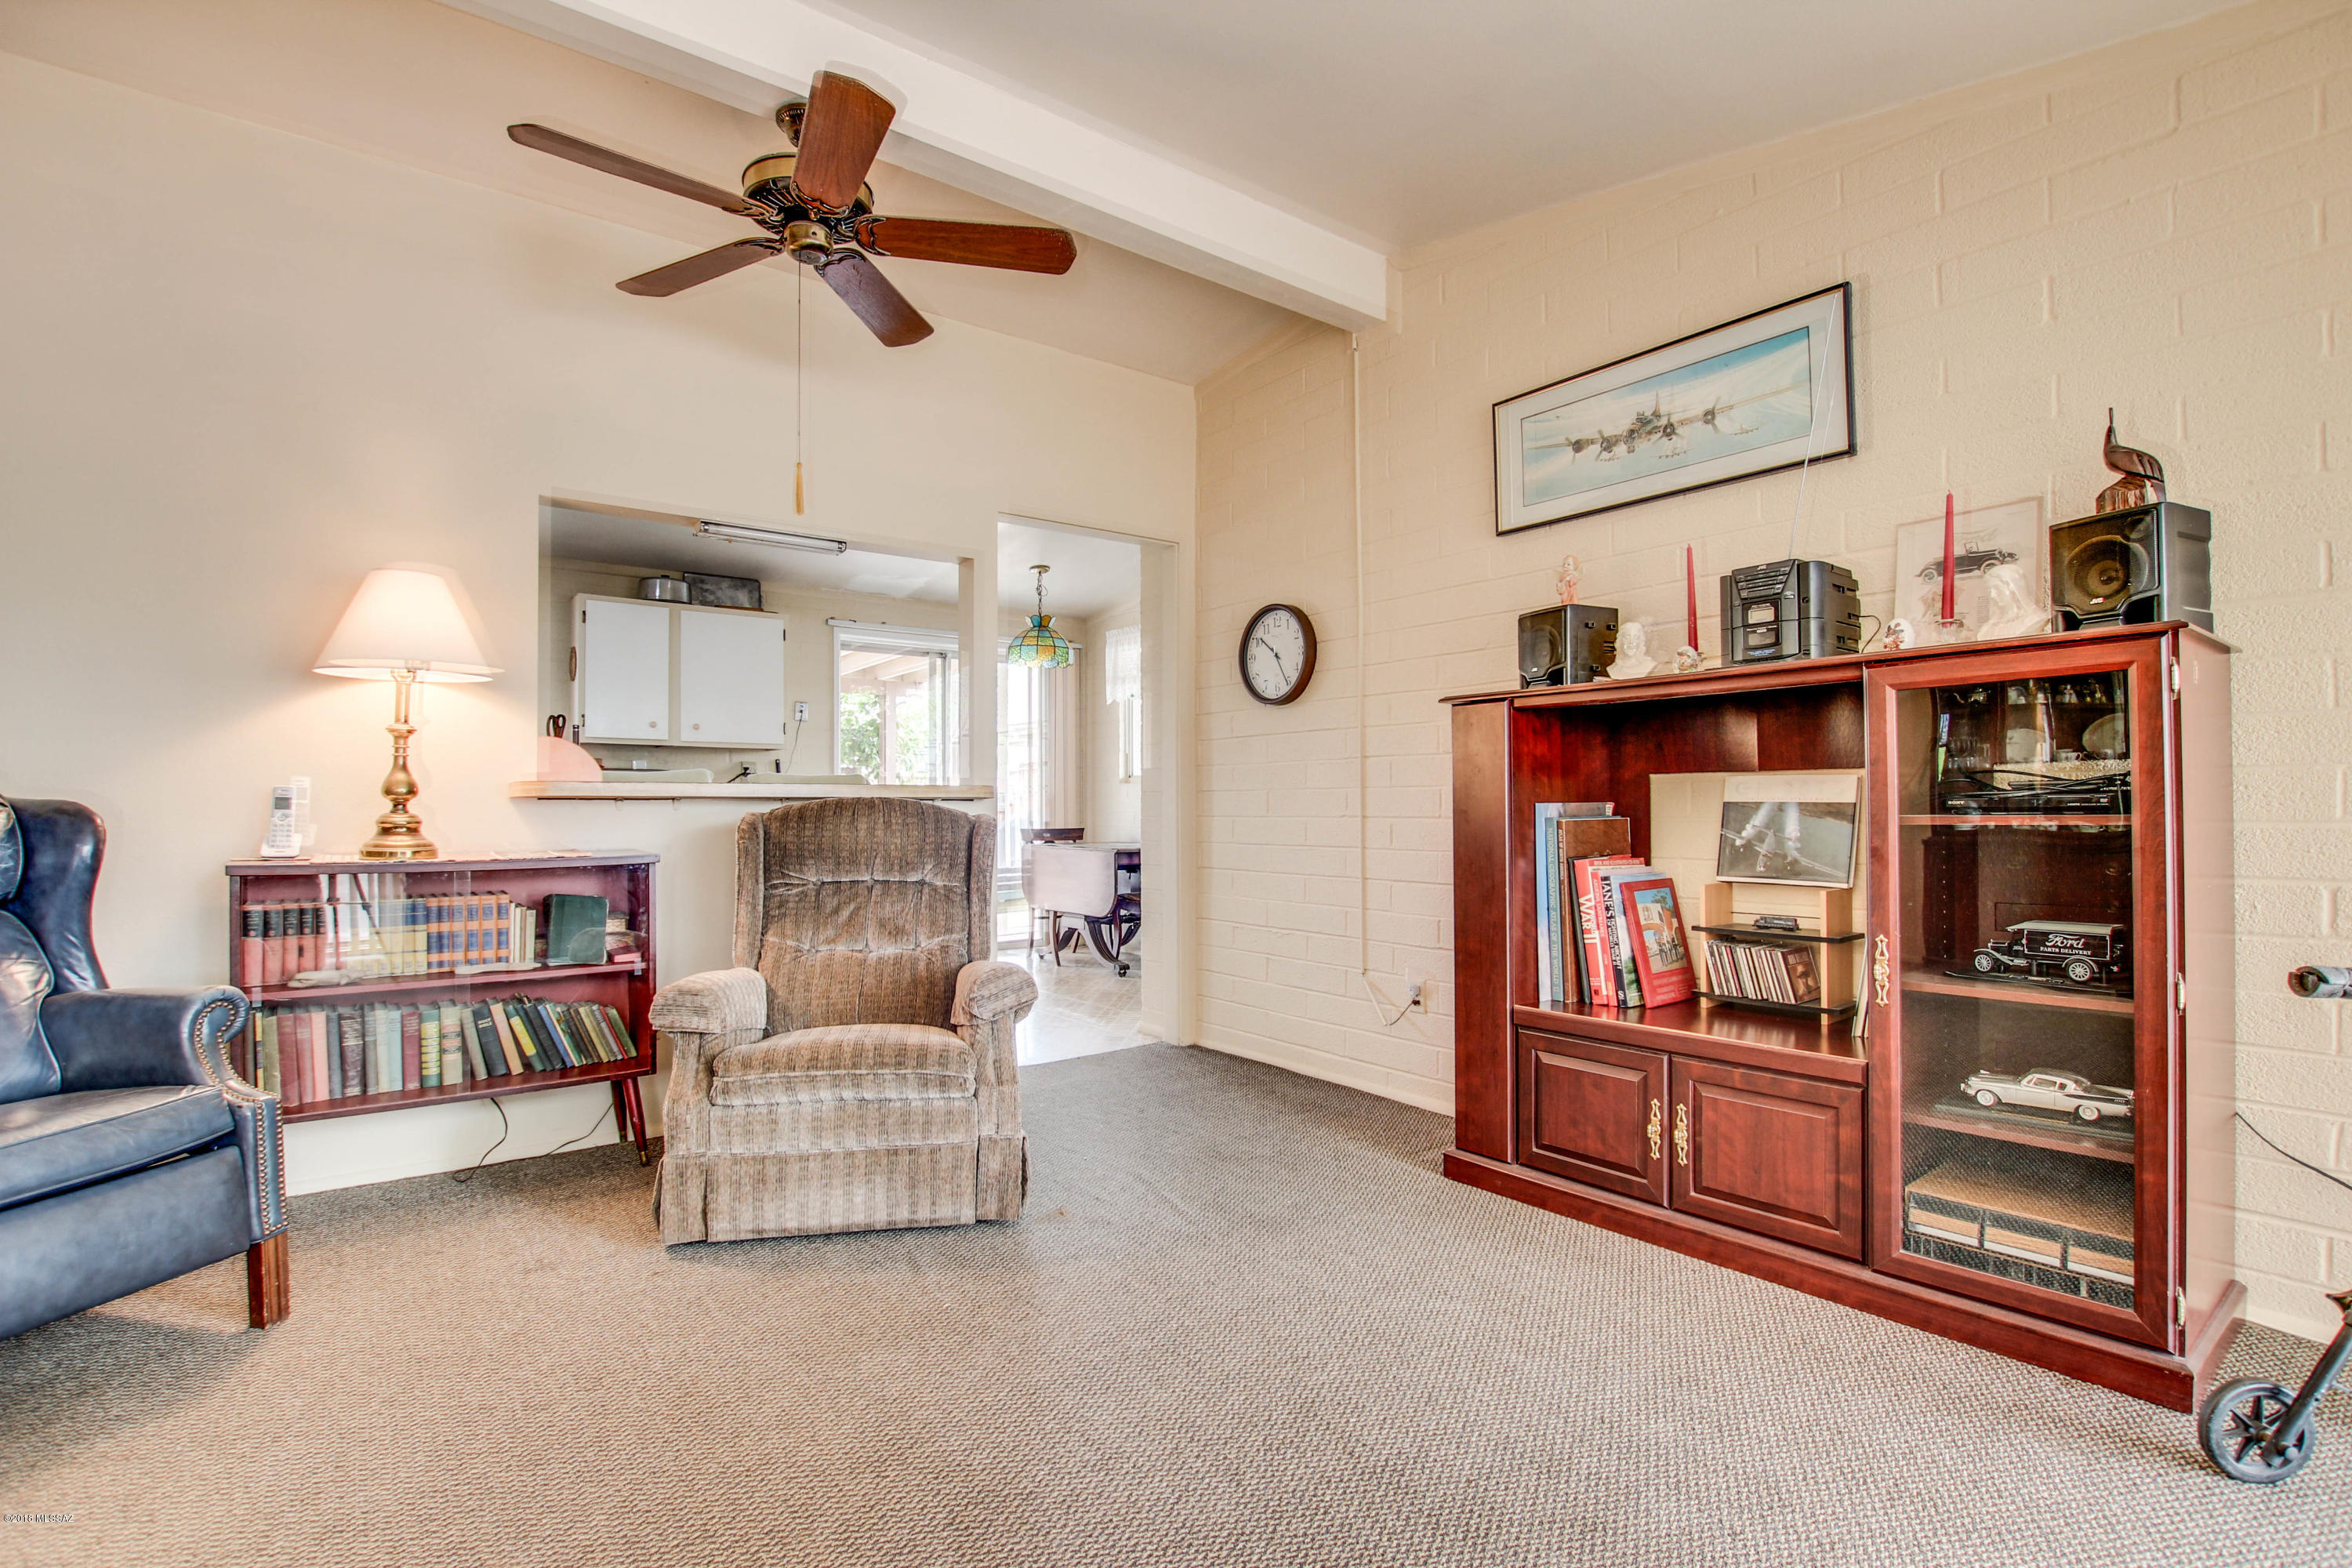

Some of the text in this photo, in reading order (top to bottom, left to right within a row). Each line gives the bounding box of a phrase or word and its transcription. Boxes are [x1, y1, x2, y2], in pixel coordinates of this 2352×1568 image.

[1273, 616, 1282, 628] 12
[1287, 618, 1290, 630] 1
[1263, 623, 1270, 635] 11
[1294, 628, 1300, 640] 2
[1255, 637, 1264, 648] 10
[1298, 645, 1305, 657] 3
[1250, 654, 1257, 665] 9
[1294, 662, 1299, 673] 4
[1275, 683, 1280, 693] 6
[1548, 864, 1557, 908] GEOGRAPHIC
[1578, 895, 1595, 930] WAR
[1611, 918, 1620, 945] FIGHTING
[2045, 933, 2086, 949] Ford
[2060, 947, 2092, 956] DELIVERY
